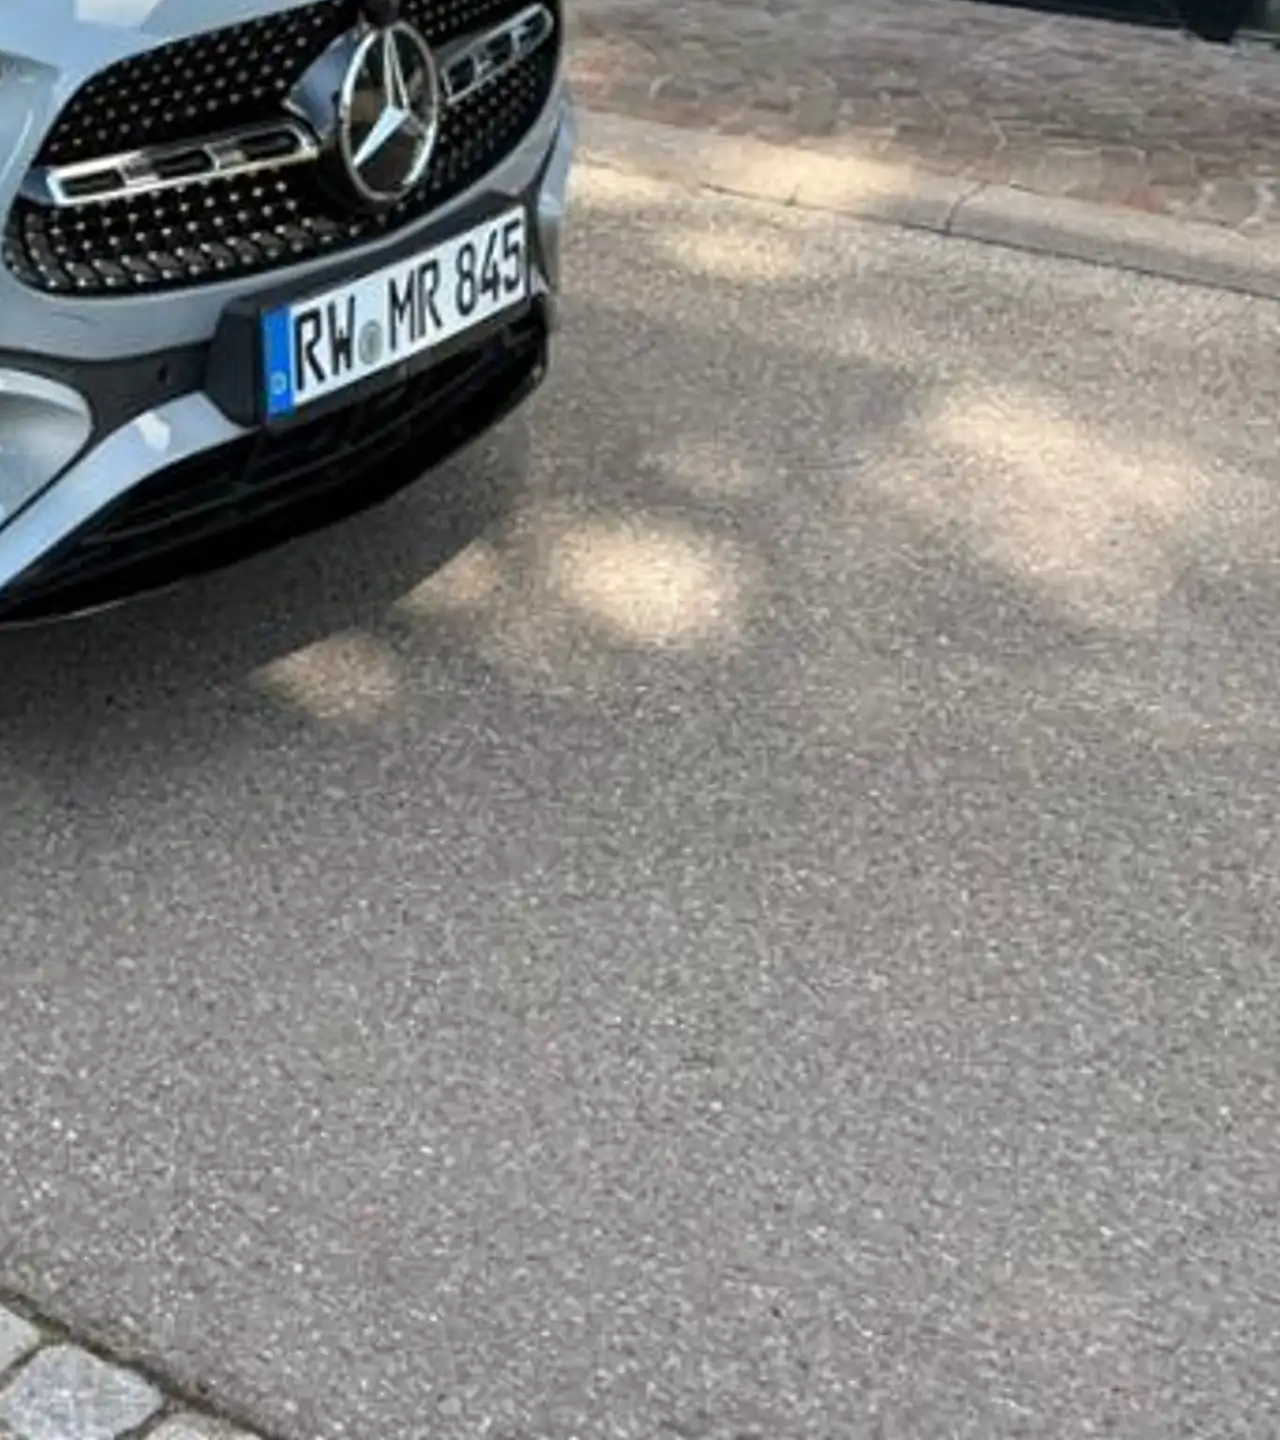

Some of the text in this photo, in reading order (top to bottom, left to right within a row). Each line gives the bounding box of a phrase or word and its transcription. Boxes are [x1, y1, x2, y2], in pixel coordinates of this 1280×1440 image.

[294, 218, 521, 391] RW MR 845
